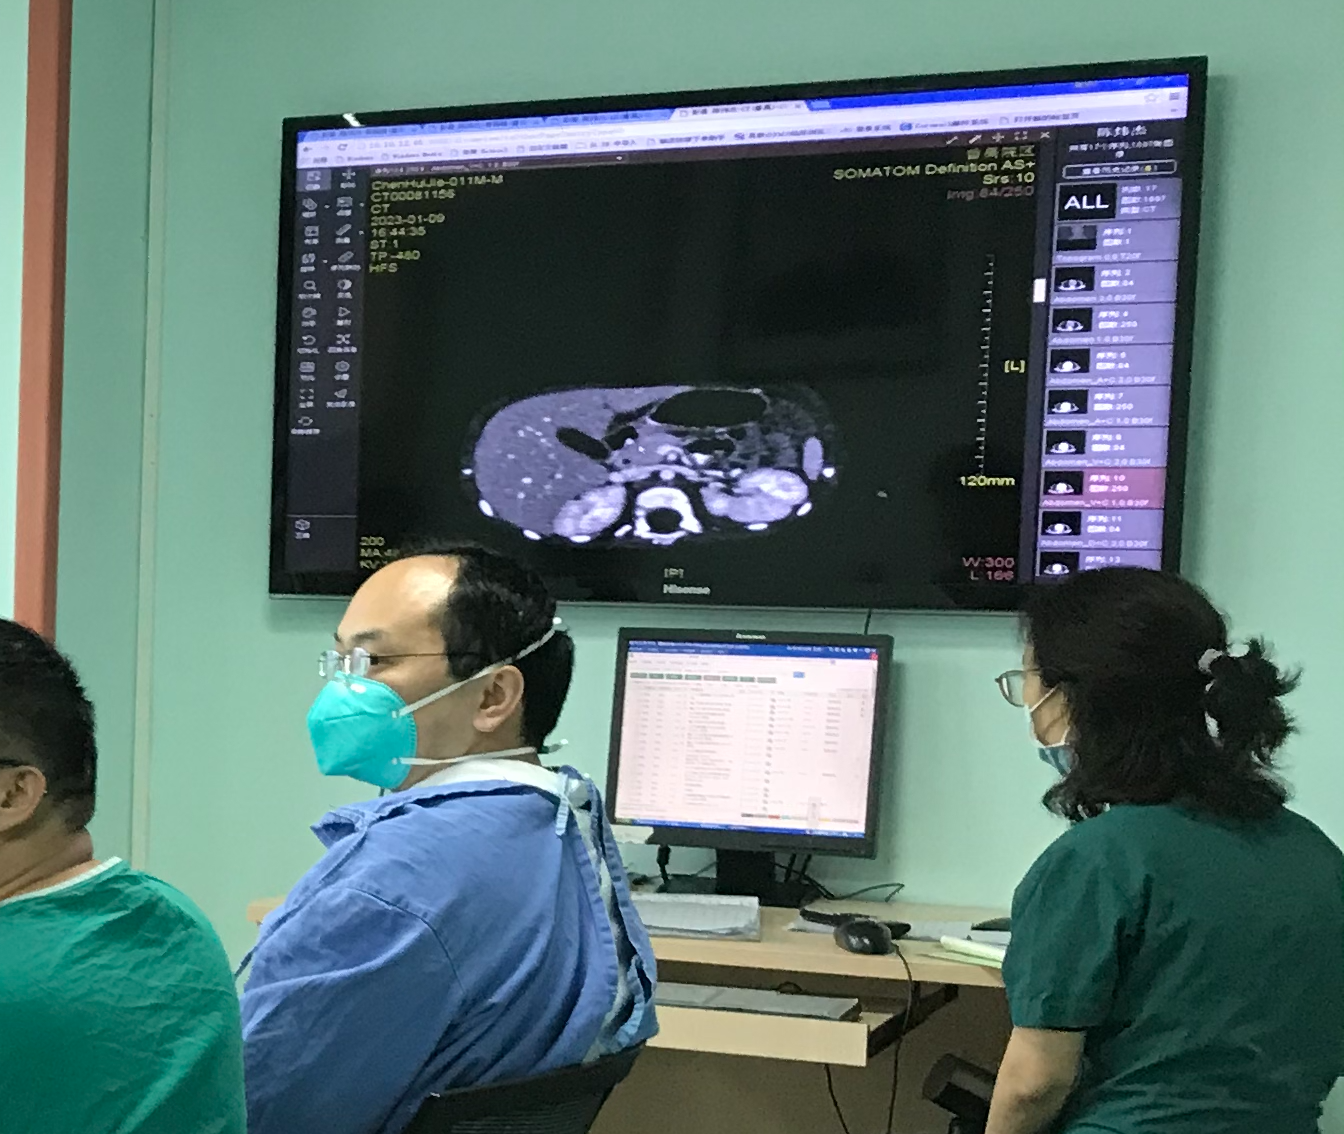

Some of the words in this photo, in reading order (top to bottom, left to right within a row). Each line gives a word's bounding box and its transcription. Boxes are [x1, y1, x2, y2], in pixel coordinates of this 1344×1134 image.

[833, 165, 920, 180] SOMATOM
[925, 162, 997, 175] Definition
[1000, 159, 1036, 171] AS+
[370, 203, 390, 214] CT
[1064, 194, 1110, 210] ALL
[370, 213, 445, 226] 2023-01-09
[369, 262, 398, 273] HFS
[1004, 360, 1025, 373] [L]
[960, 475, 1016, 486] 120mm
